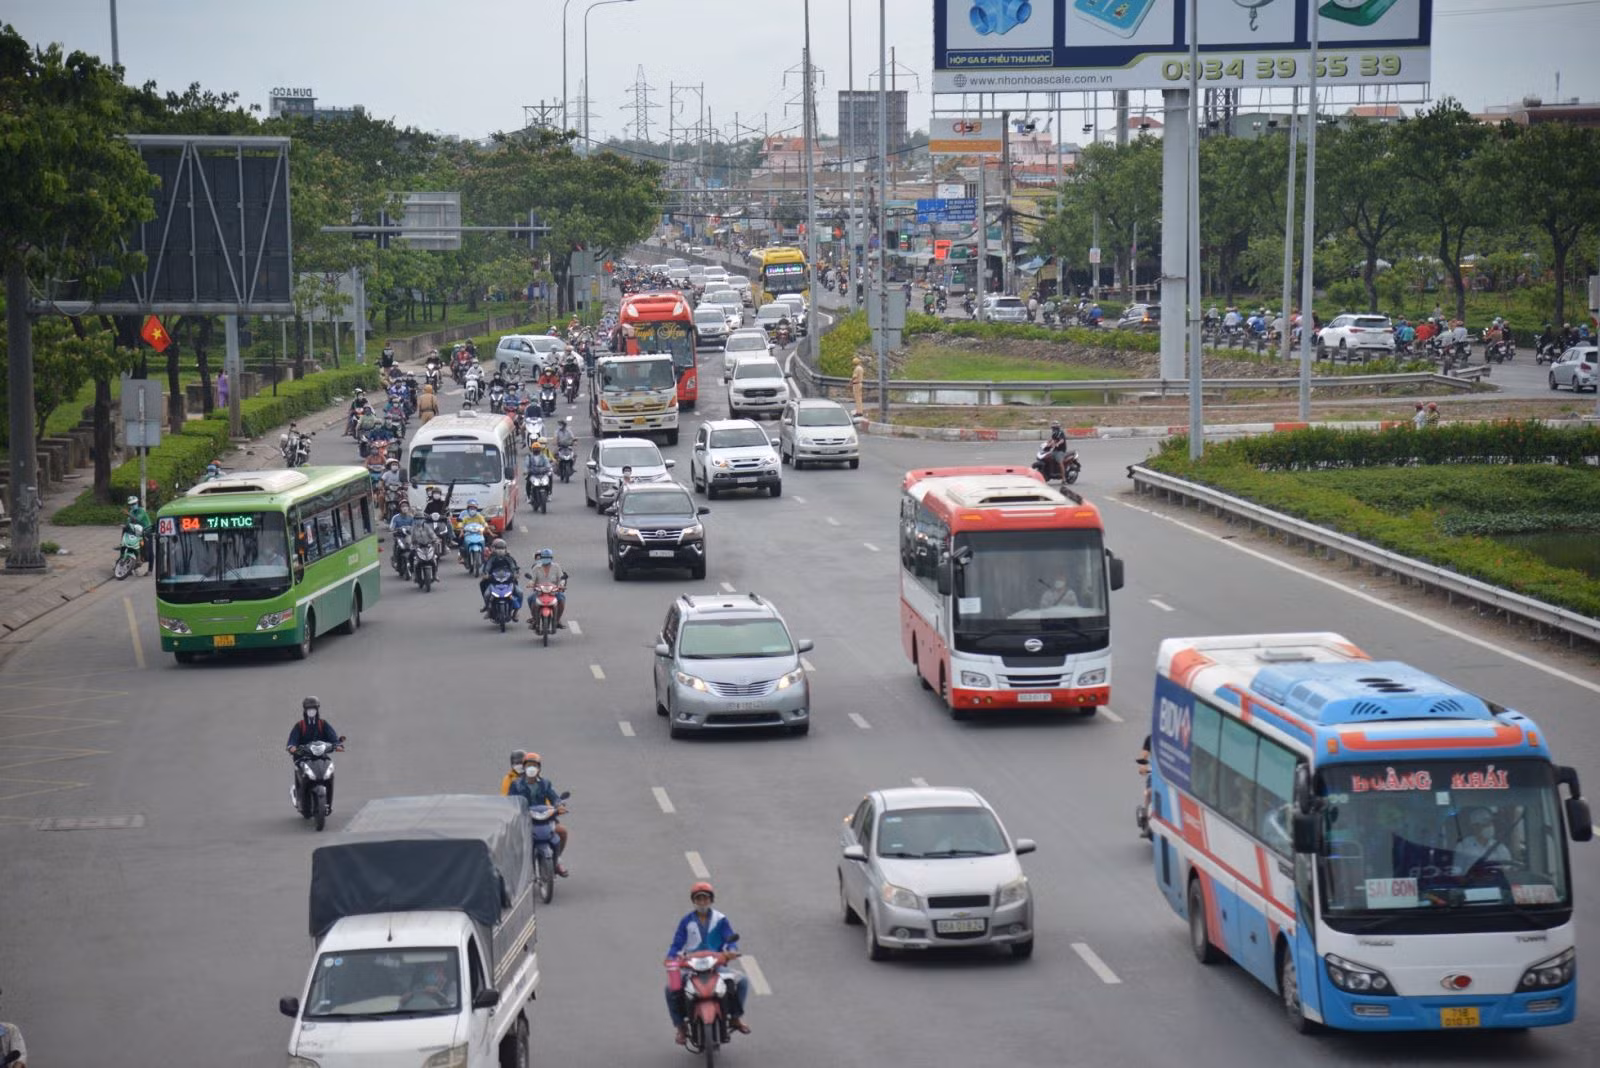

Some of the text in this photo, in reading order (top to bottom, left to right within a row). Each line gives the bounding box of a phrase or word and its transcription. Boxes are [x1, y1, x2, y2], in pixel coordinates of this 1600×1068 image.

[1161, 58, 1245, 80] 0934
[1255, 57, 1297, 79] 39
[1359, 54, 1402, 76] 39
[969, 74, 1113, 86] www.nhonhoascale.com.vn
[159, 519, 173, 534] 84
[182, 517, 200, 530] 84
[230, 515, 253, 527] TÚC
[1159, 697, 1183, 741] BIDV
